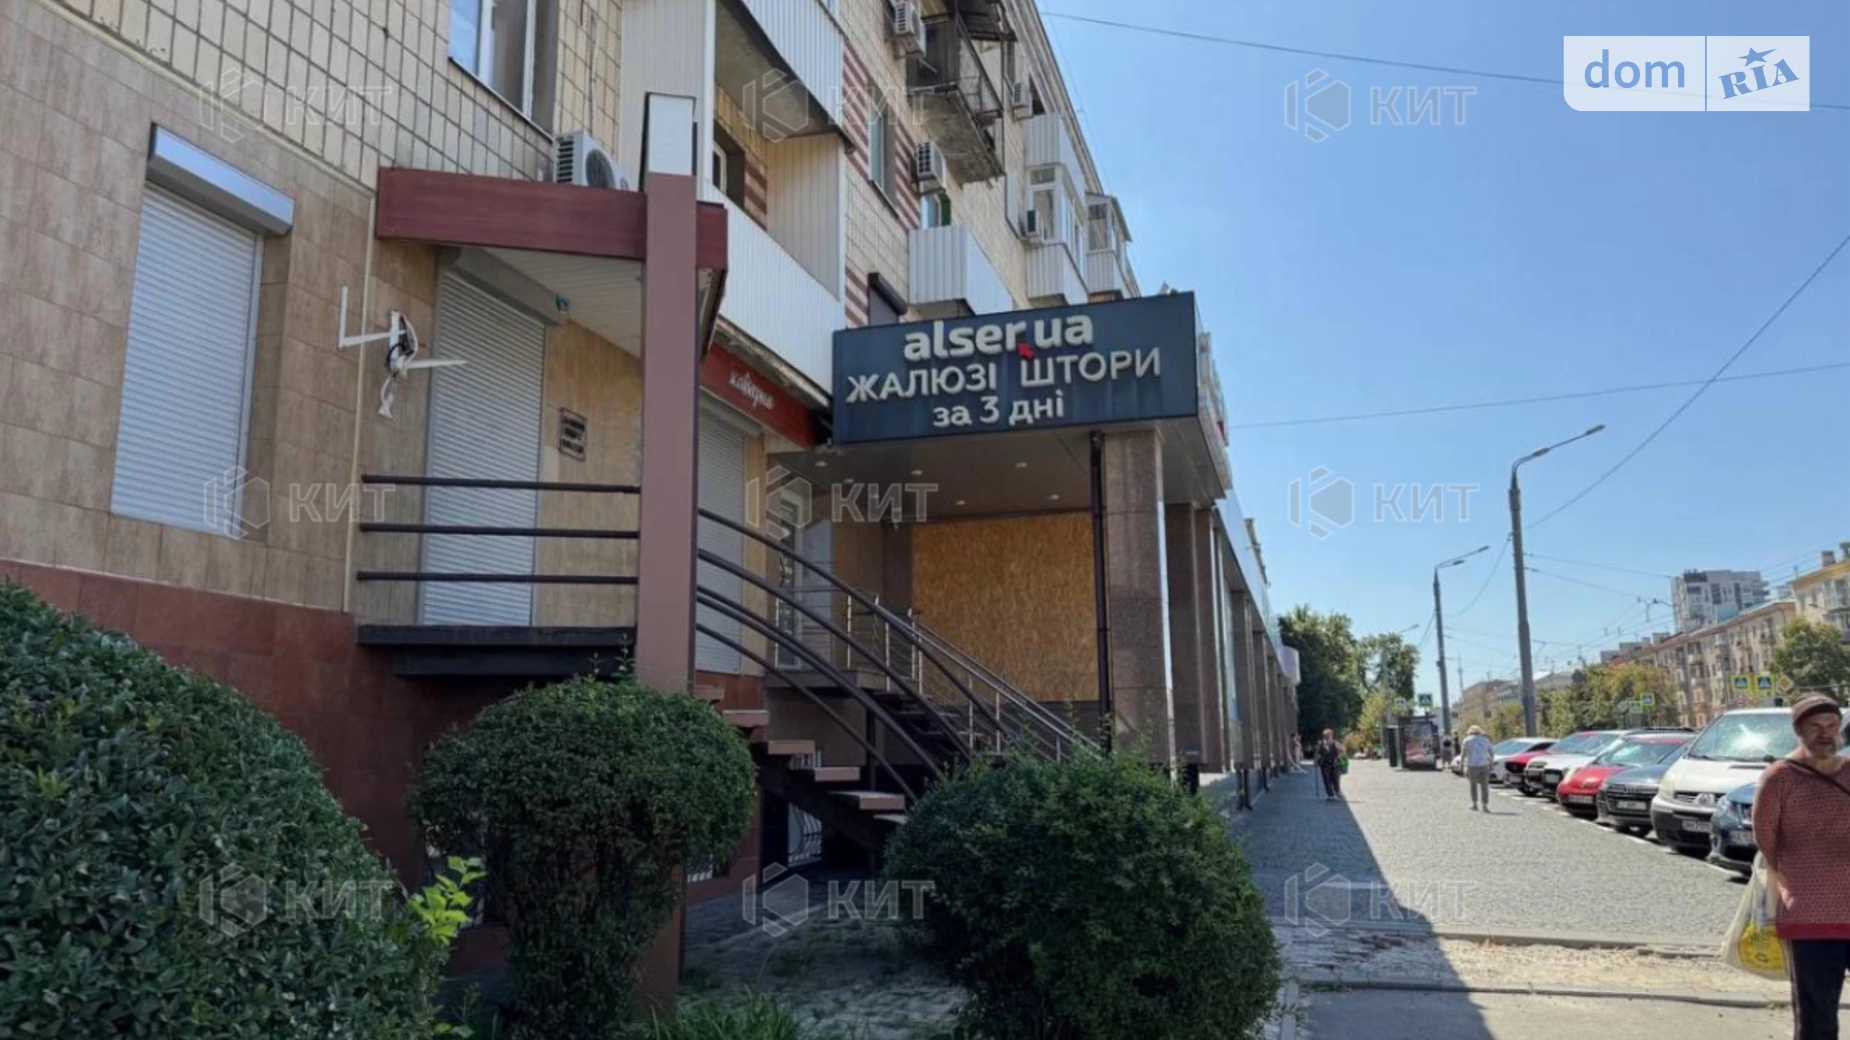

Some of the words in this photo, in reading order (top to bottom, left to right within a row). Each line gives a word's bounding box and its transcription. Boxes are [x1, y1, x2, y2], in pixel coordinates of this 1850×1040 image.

[846, 363, 997, 403] ЖАЛЮЗІ
[1020, 347, 1161, 388] ШТОРИ
[932, 405, 973, 428] за
[979, 395, 1000, 424] 3
[1008, 389, 1064, 426] дні
